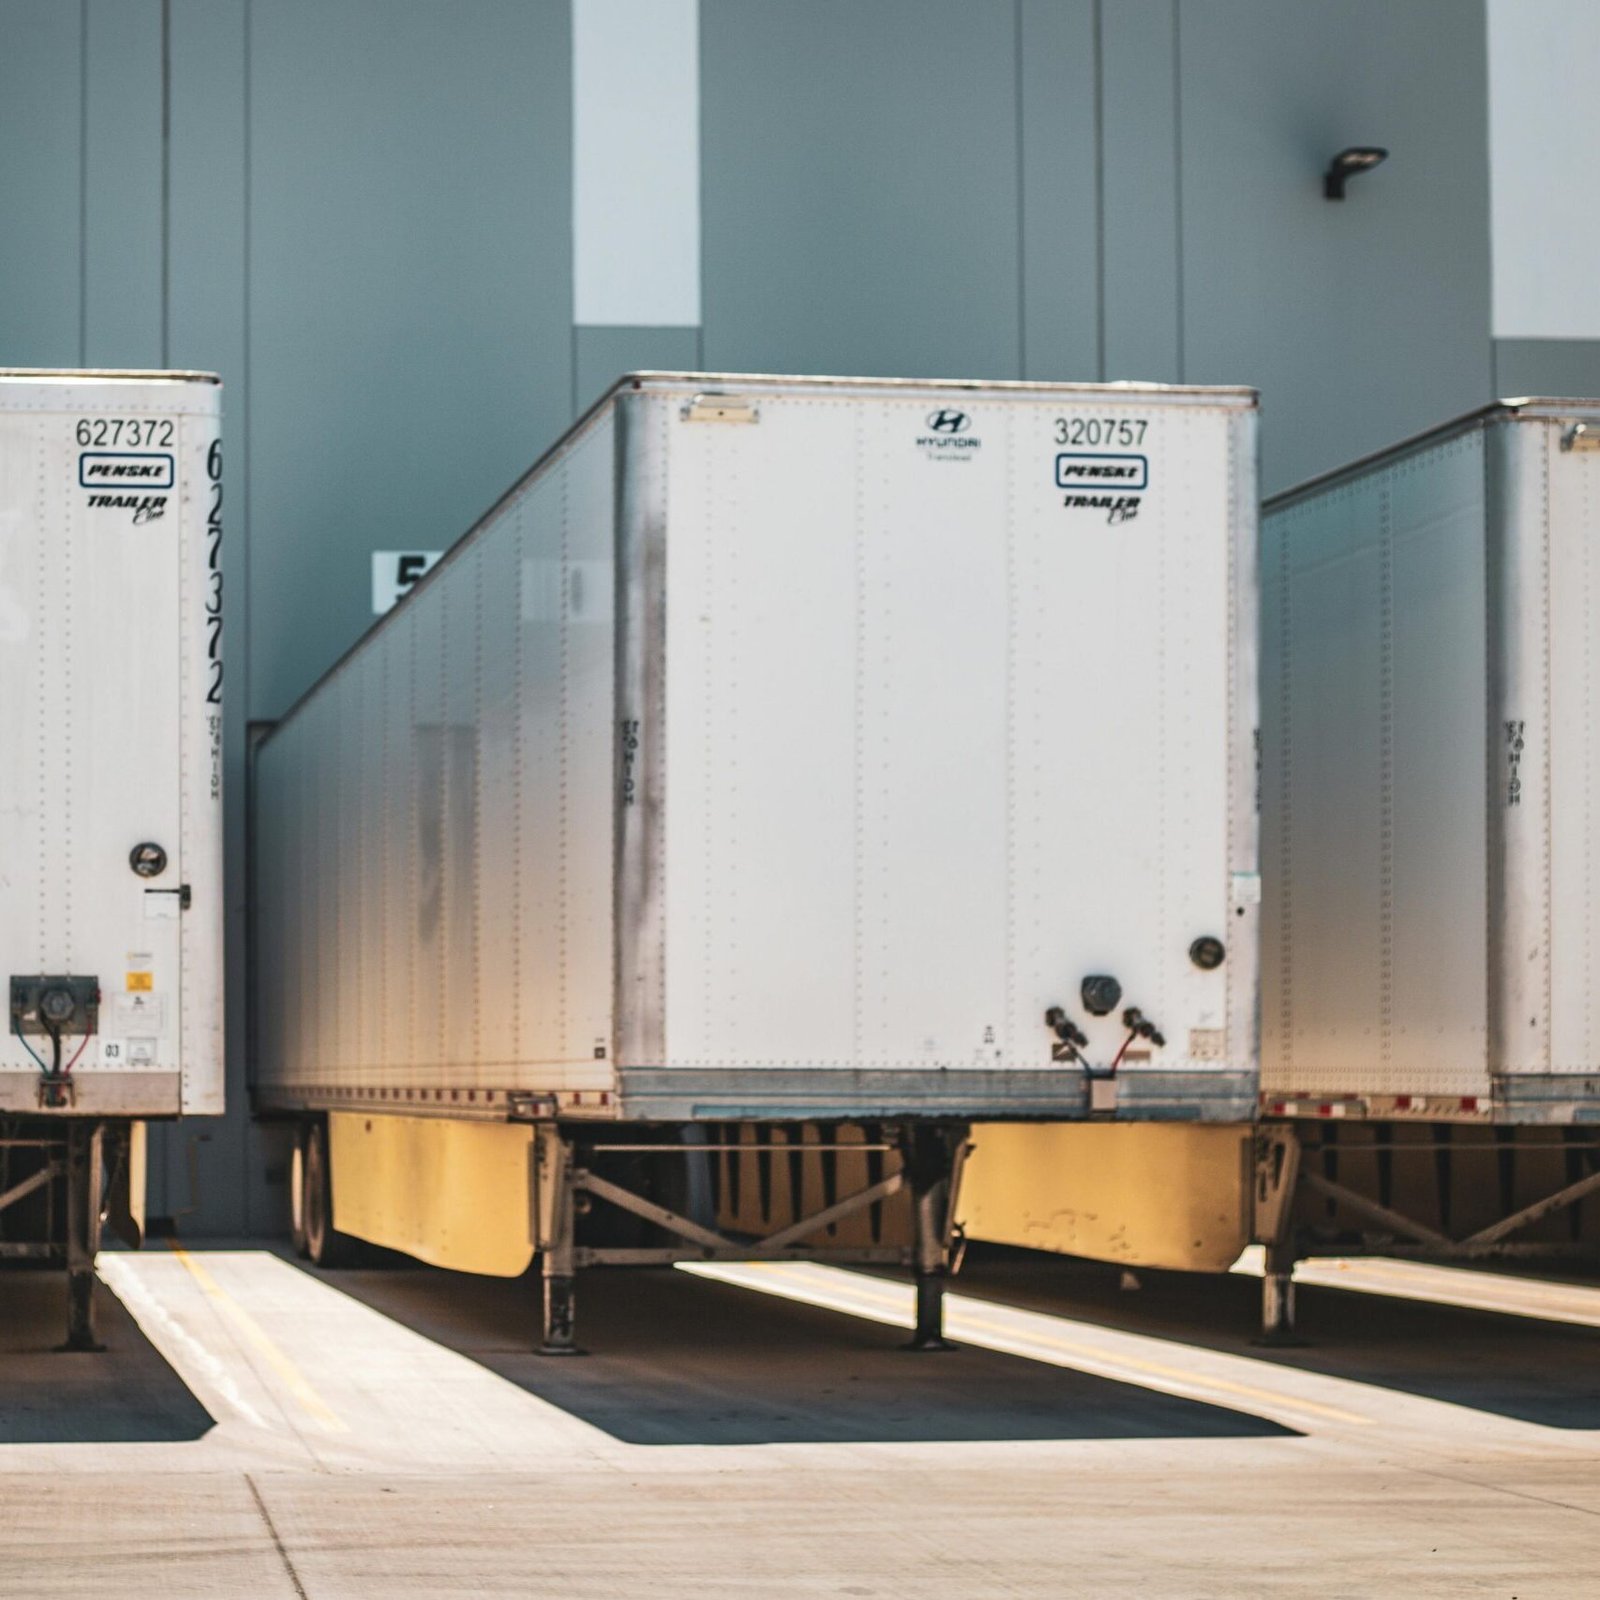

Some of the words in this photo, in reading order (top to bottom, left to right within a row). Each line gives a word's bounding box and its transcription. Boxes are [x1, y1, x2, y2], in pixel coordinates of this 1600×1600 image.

[76, 418, 174, 448] 627372
[1055, 417, 1148, 446] 320757
[915, 436, 981, 448] HYUNDAI
[87, 464, 166, 478] PENSKE
[1064, 464, 1139, 479] PENSKE
[87, 495, 168, 511] TRAILER
[1064, 495, 1141, 511] TRAILER
[206, 438, 223, 704] 627372
